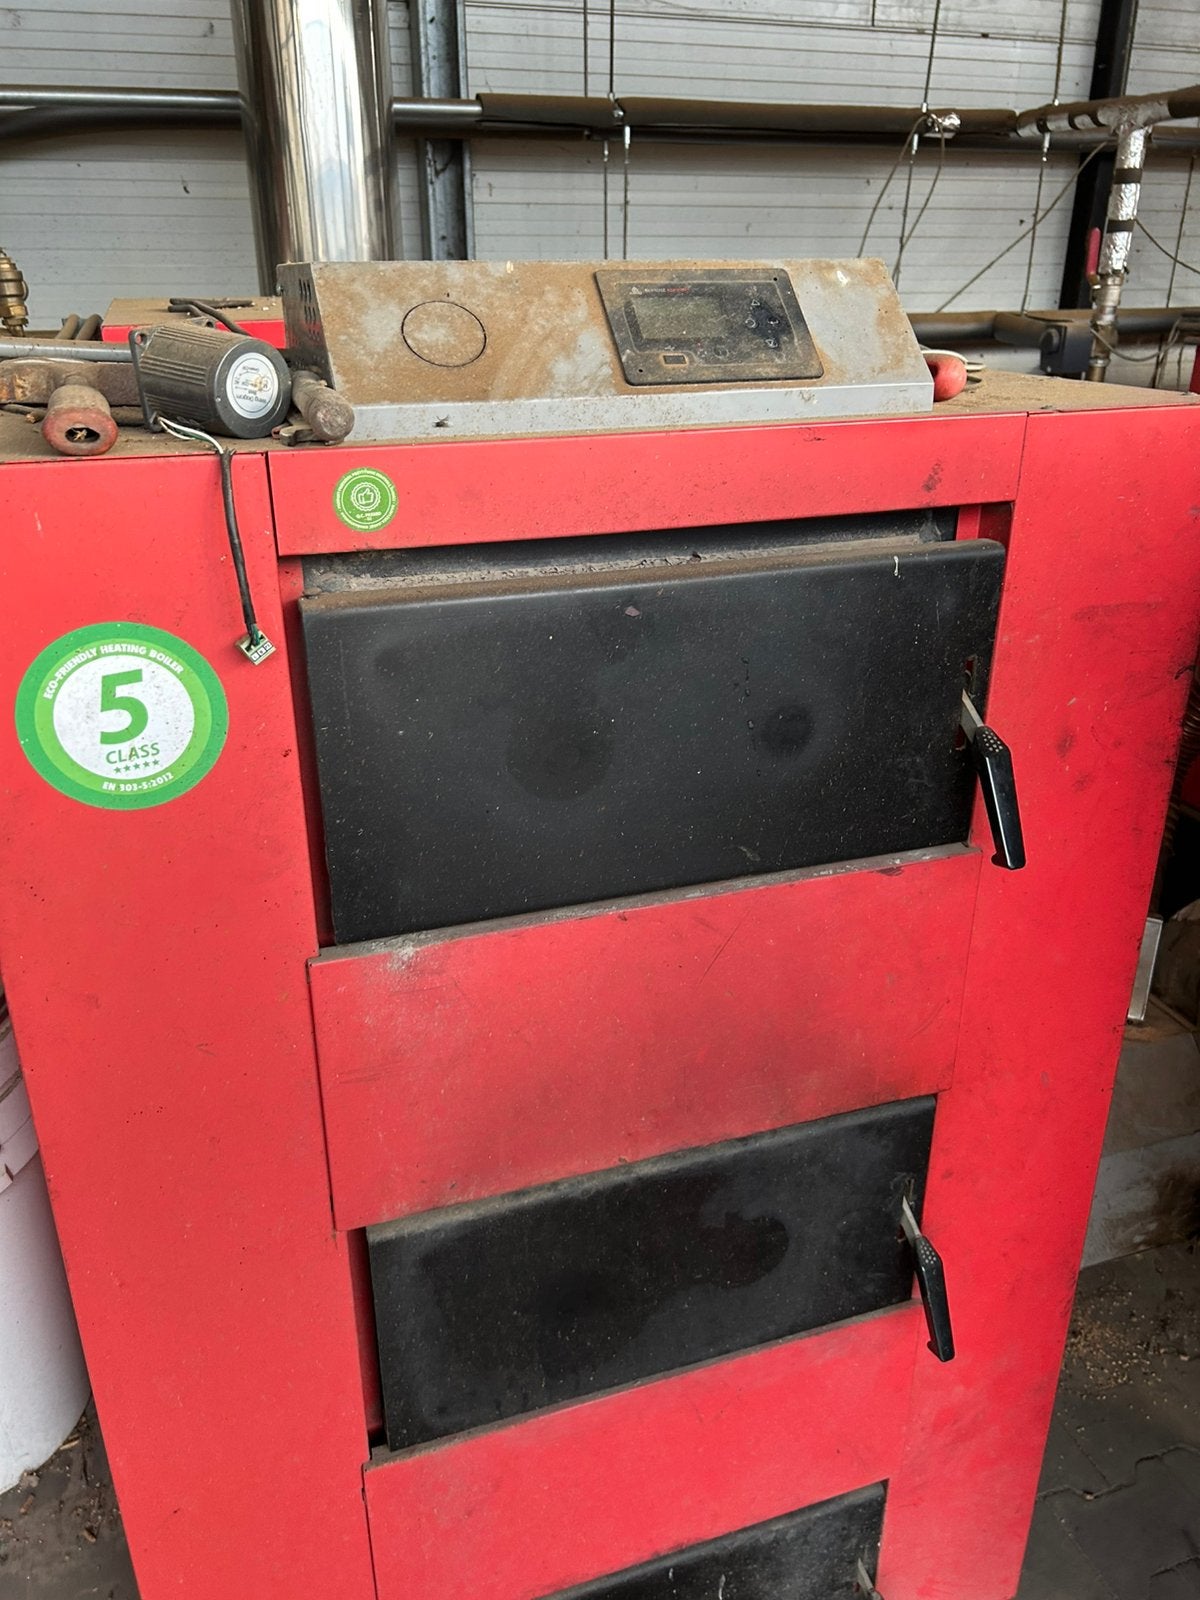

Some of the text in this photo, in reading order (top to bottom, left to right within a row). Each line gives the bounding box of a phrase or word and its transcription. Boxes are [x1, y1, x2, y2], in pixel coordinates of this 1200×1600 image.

[43, 643, 184, 700] ECO-FRIENDLY HEATING BOILER
[99, 668, 149, 745] 5
[106, 742, 160, 765] CLASS
[102, 772, 175, 792] EN 303-5:2012
